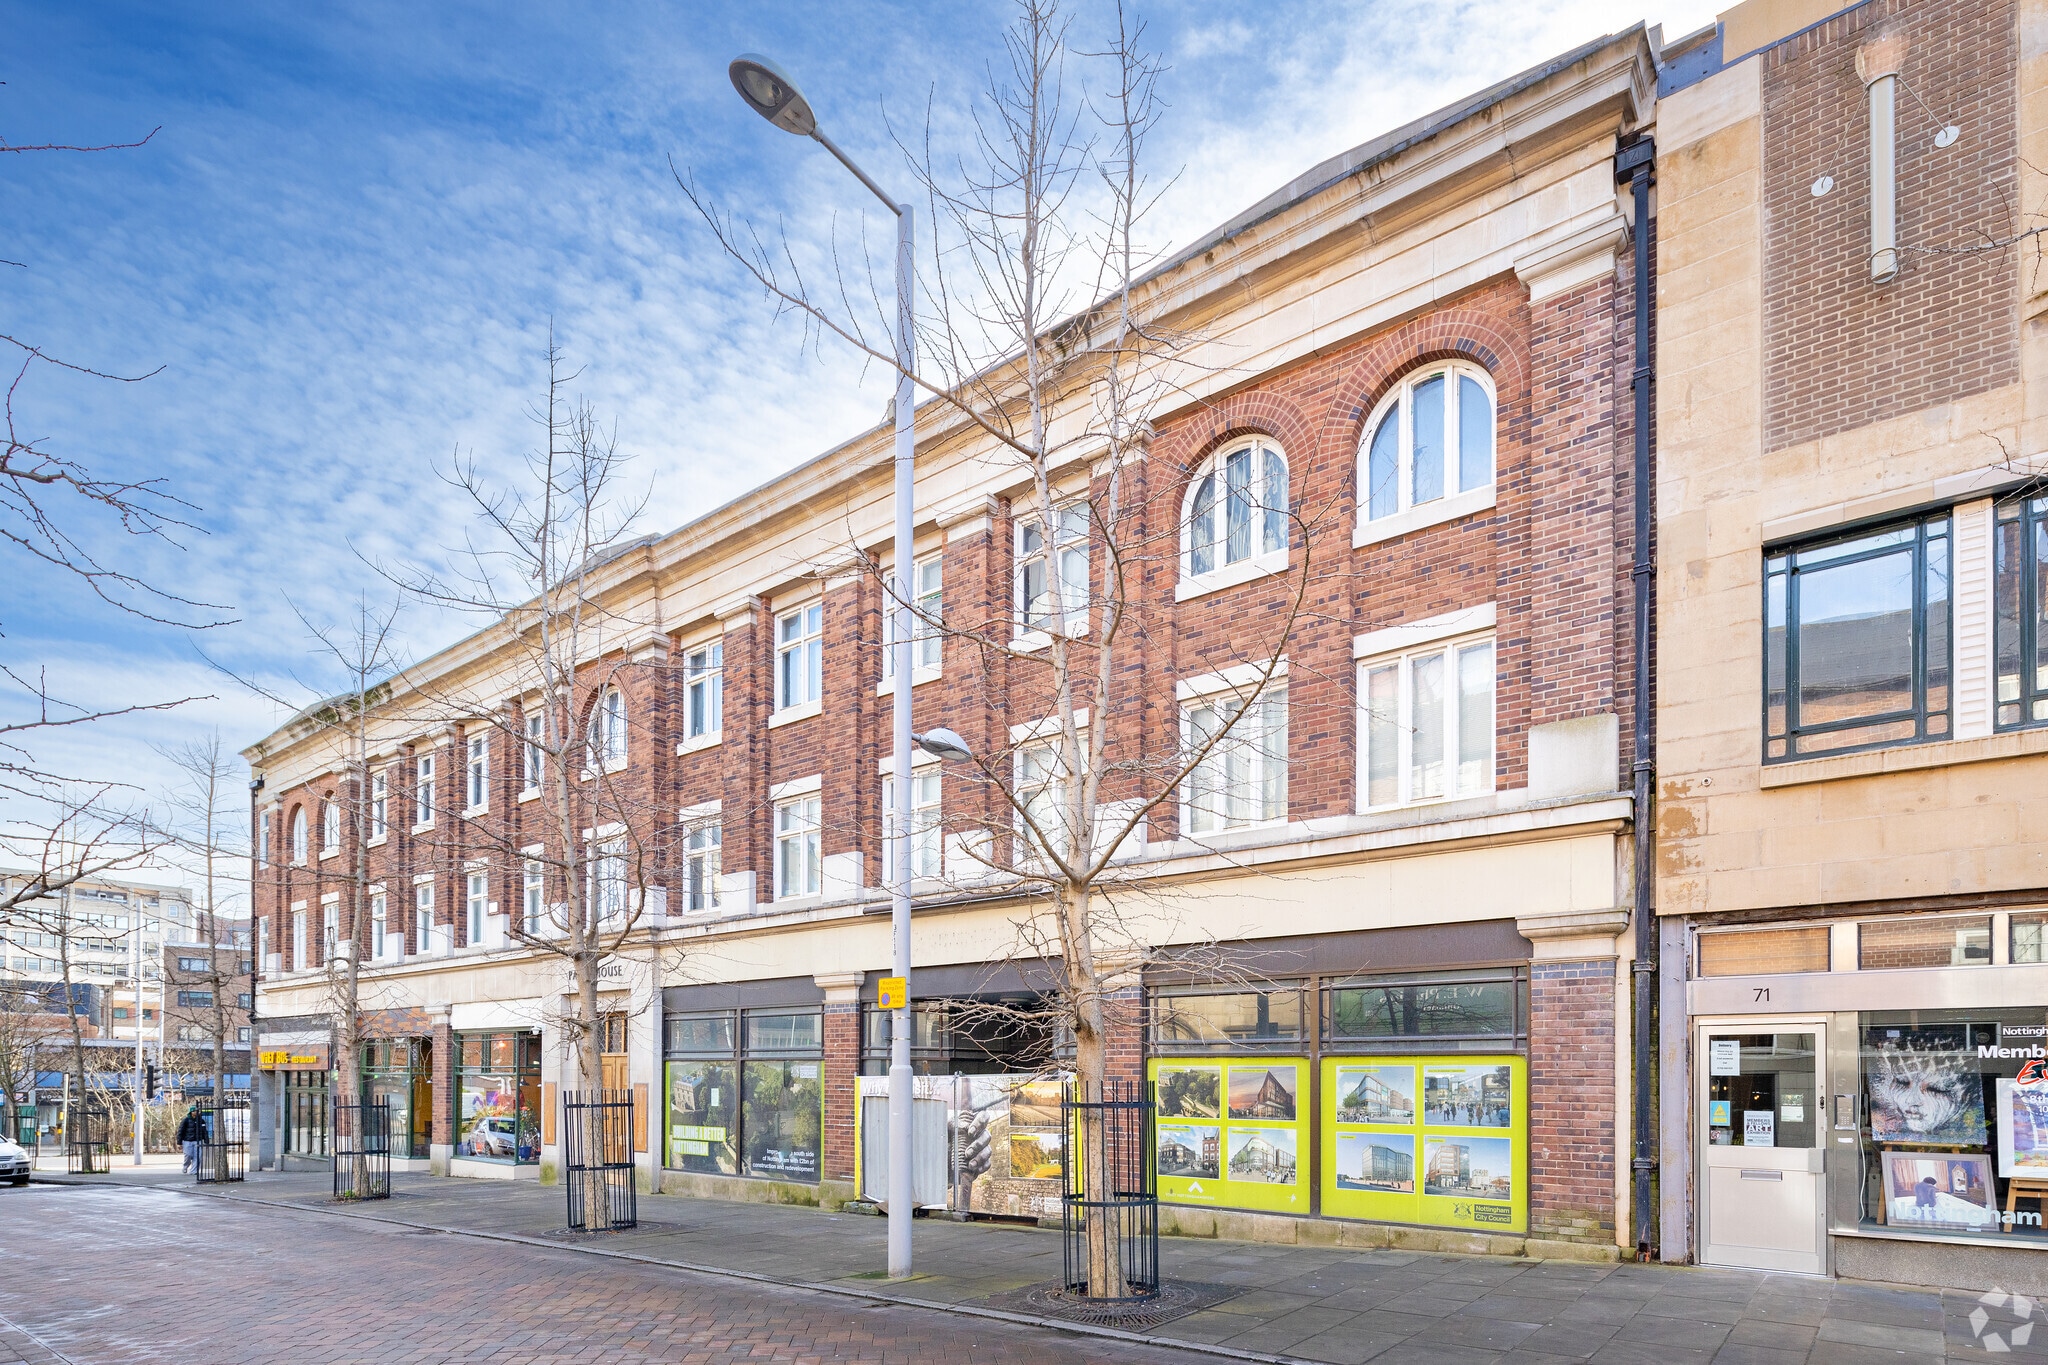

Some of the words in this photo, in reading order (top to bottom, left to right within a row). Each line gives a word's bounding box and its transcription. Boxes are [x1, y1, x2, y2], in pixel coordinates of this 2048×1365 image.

[1753, 988, 1769, 1002] 71
[1977, 1044, 2048, 1058] Memb
[1475, 1205, 1510, 1214] Nottingham
[1888, 1201, 2043, 1227] Nottingham
